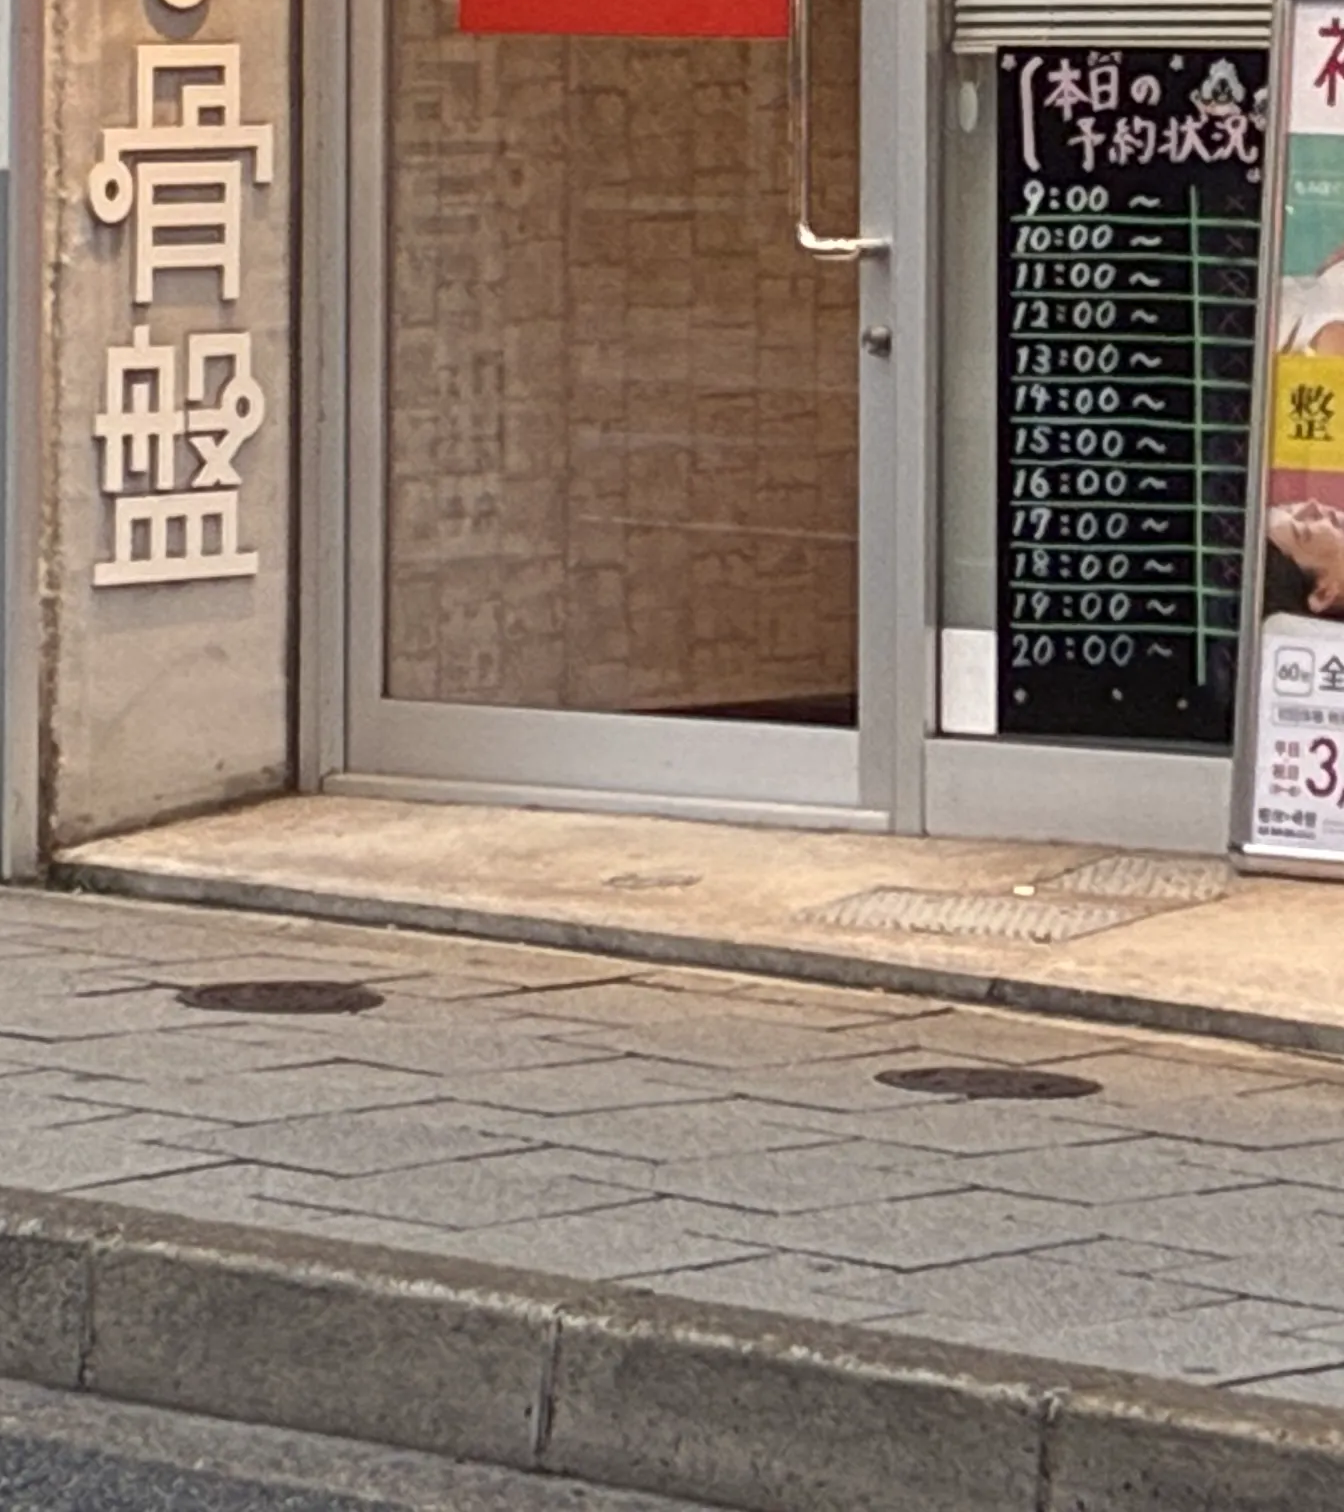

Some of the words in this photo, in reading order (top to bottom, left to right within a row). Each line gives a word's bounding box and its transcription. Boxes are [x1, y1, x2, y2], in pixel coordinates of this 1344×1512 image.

[1044, 57, 1162, 122] 本日の
[1067, 114, 1259, 173] 予約状況
